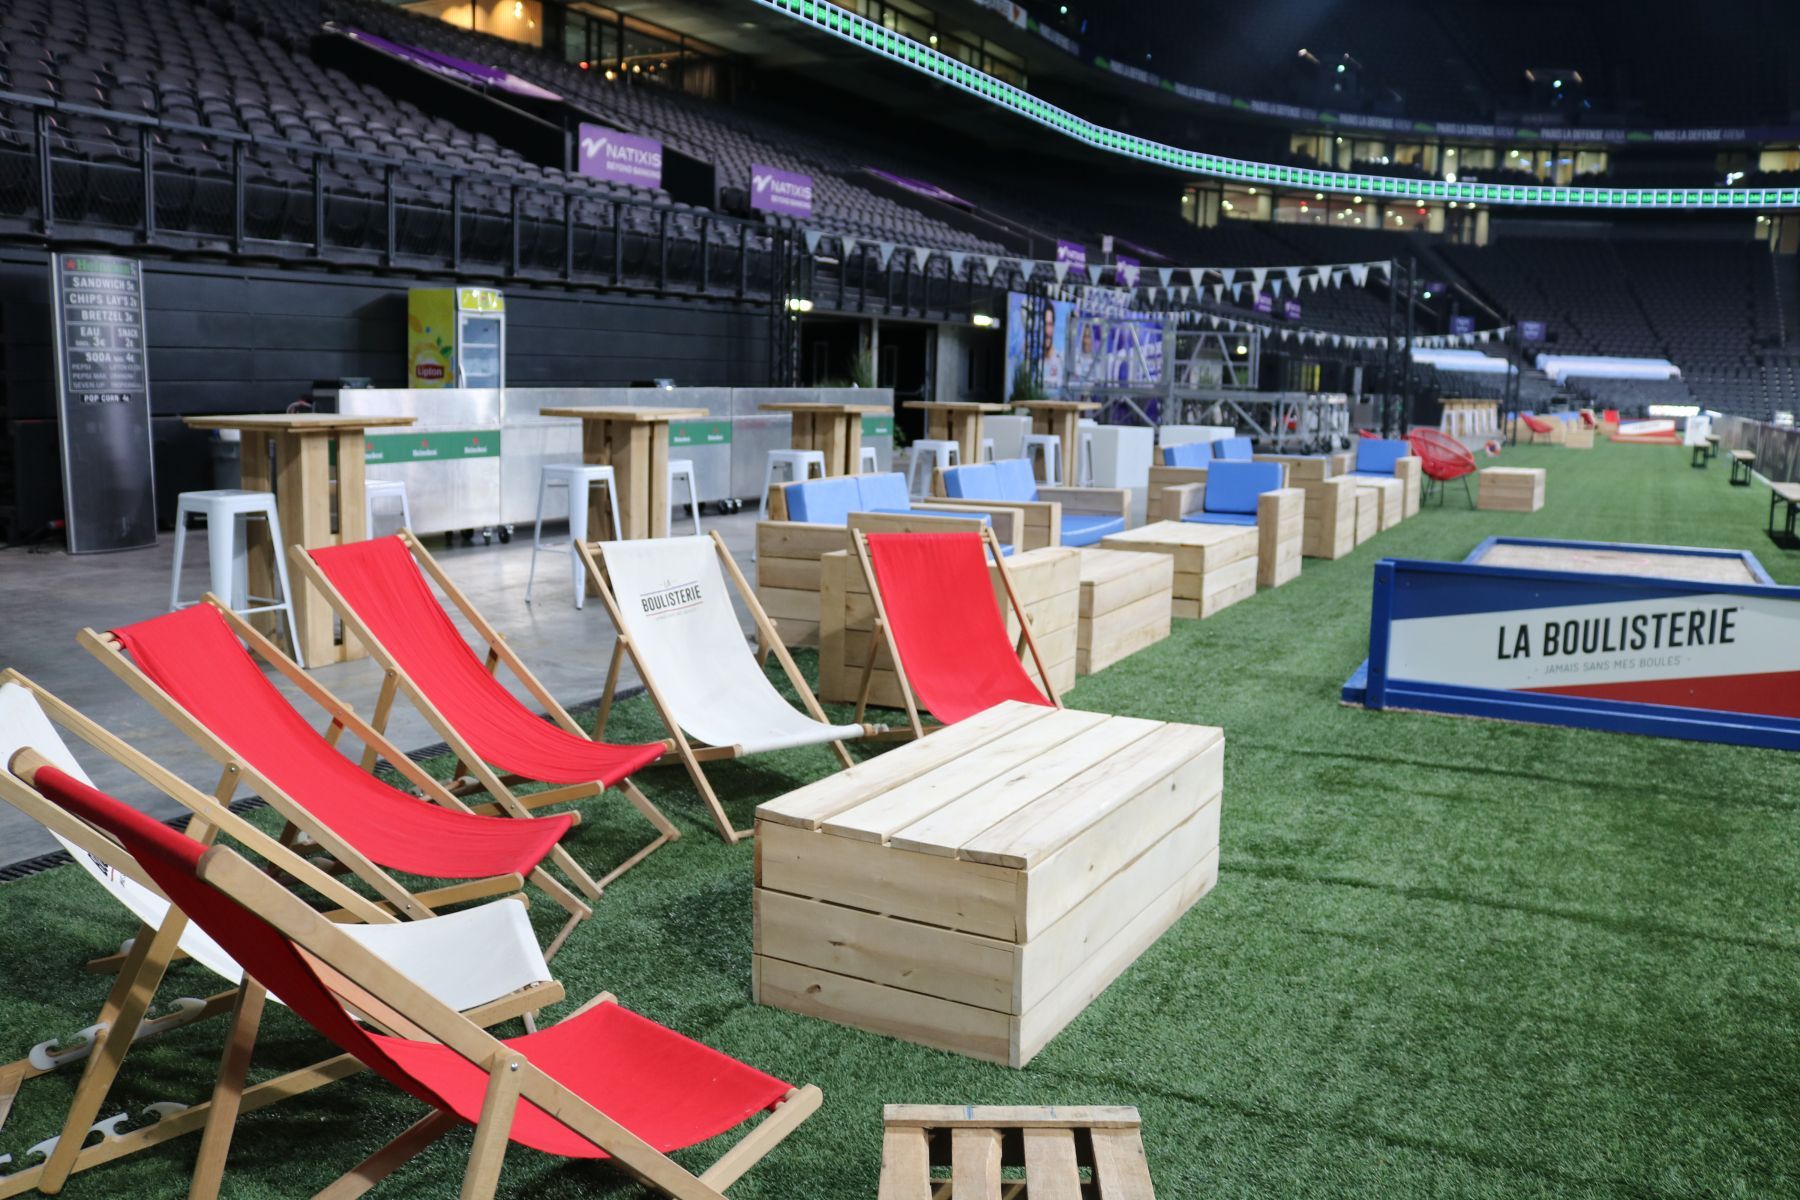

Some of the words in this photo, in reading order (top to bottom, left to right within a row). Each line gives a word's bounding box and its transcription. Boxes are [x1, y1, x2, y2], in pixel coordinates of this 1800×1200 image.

[606, 143, 662, 168] NATIXIS
[72, 276, 125, 290] SANDWICH
[69, 293, 103, 305] CHIPS
[81, 310, 122, 321] BRETZEL
[80, 326, 101, 337] EAU
[85, 351, 112, 362] SODA
[417, 368, 443, 377] Lipton
[641, 584, 702, 612] BOULISTERIE
[1497, 624, 1531, 660] LA
[1543, 607, 1738, 657] BOULISTERIE
[1543, 663, 1580, 675] JAMAIS
[1583, 661, 1610, 672] SANS
[1614, 659, 1637, 669] MES
[1639, 656, 1682, 667] BOULES
